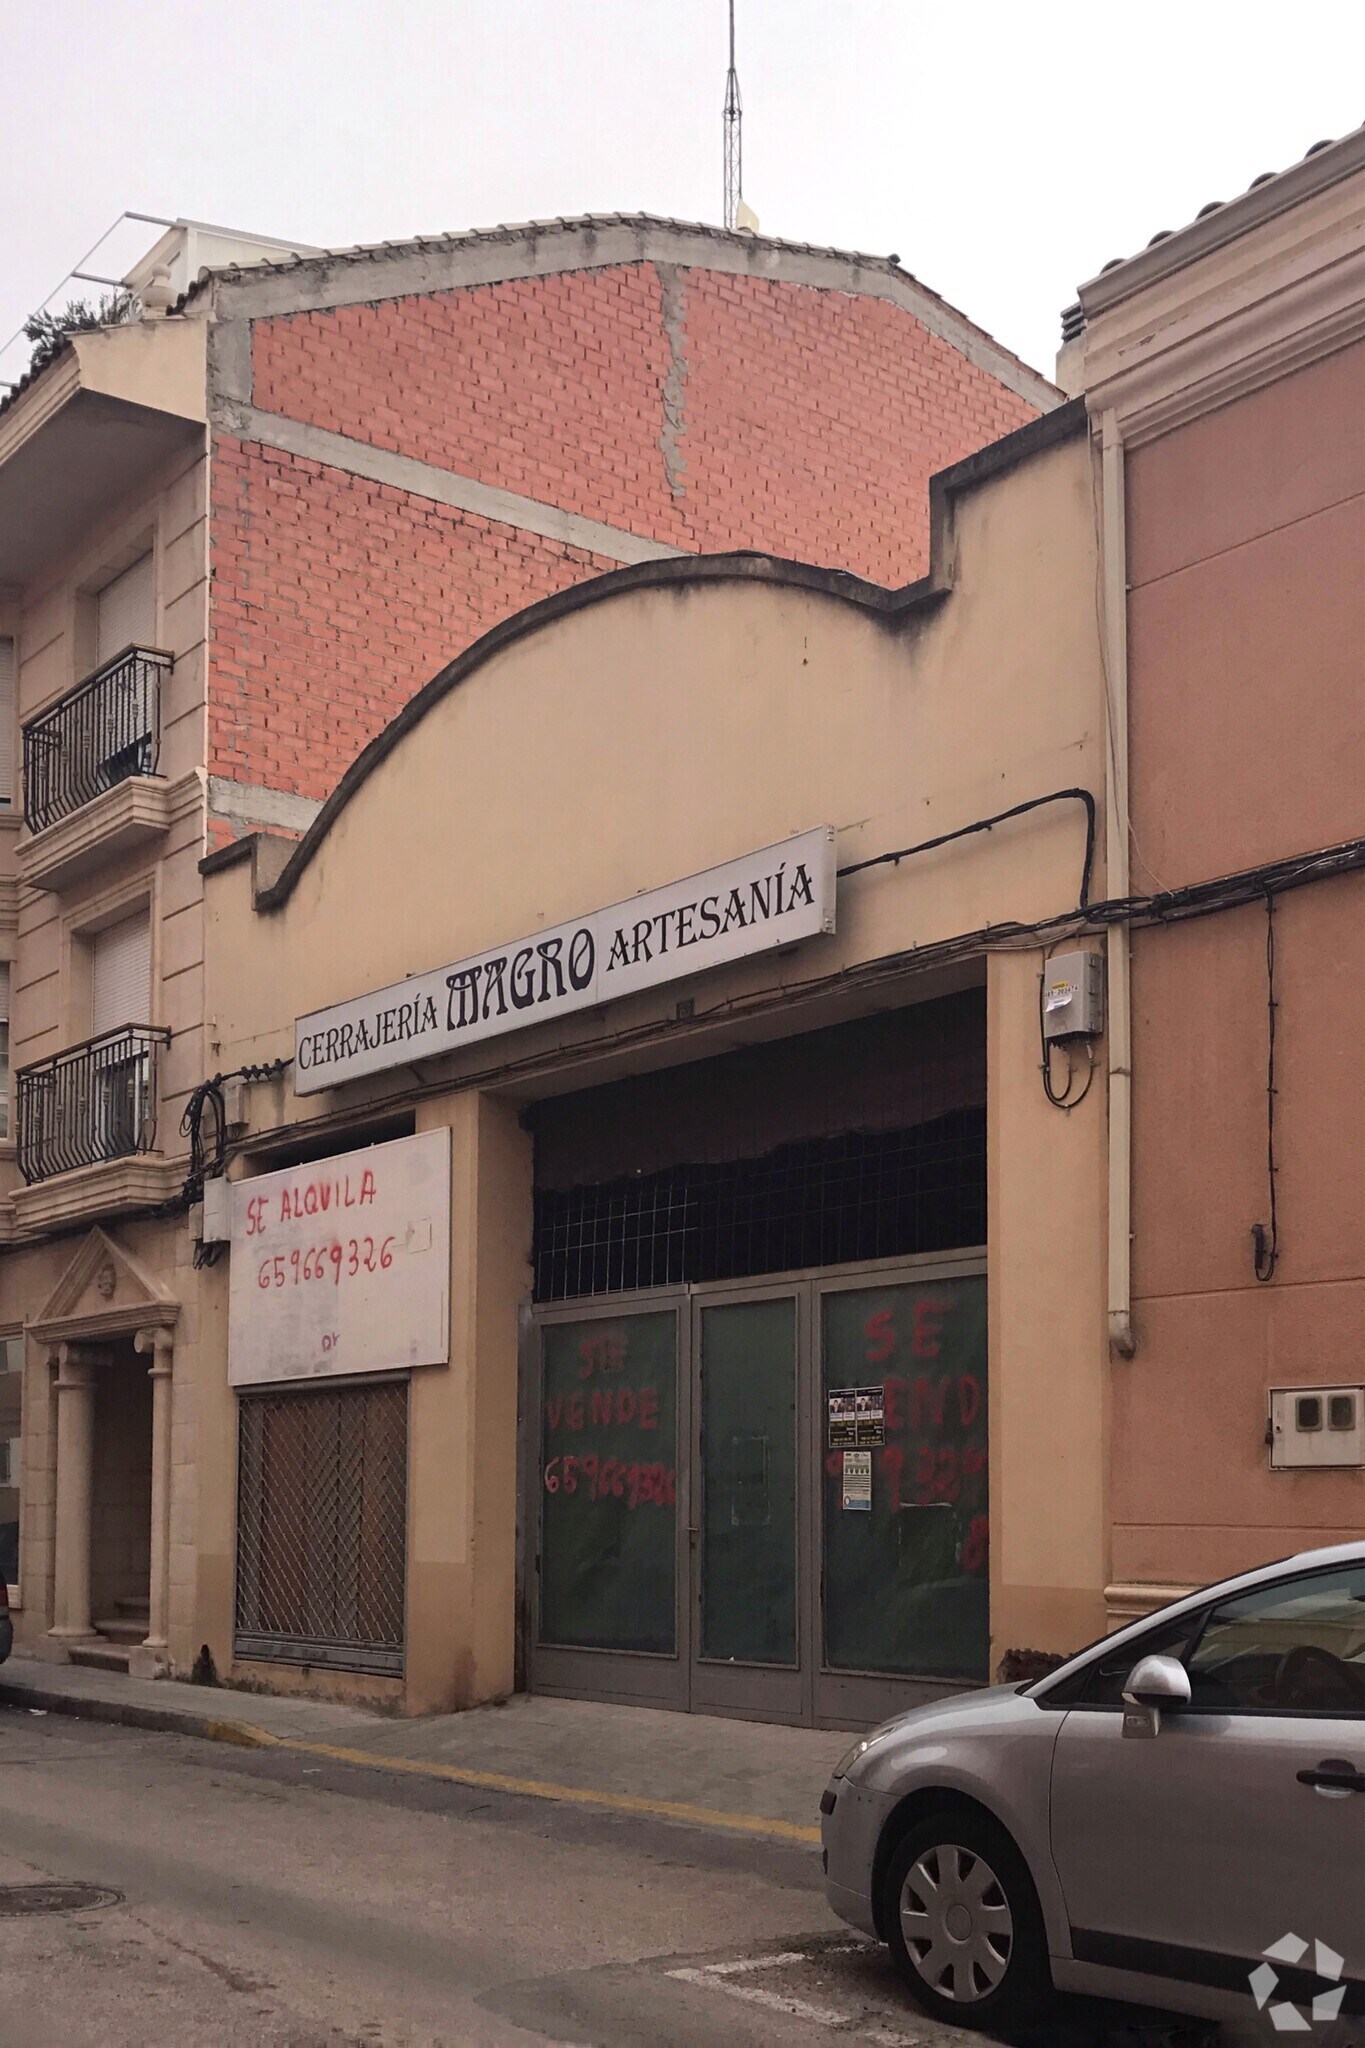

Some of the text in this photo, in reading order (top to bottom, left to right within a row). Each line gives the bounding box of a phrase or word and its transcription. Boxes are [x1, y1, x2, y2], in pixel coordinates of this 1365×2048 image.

[298, 862, 816, 1071] CERRAJERÍA MAGRO ARTESANÍA
[246, 1198, 269, 1236] SE
[258, 1236, 396, 1289] 659669326
[863, 1299, 957, 1361] SE
[545, 1386, 660, 1432] VENDE
[883, 1373, 981, 1429] END
